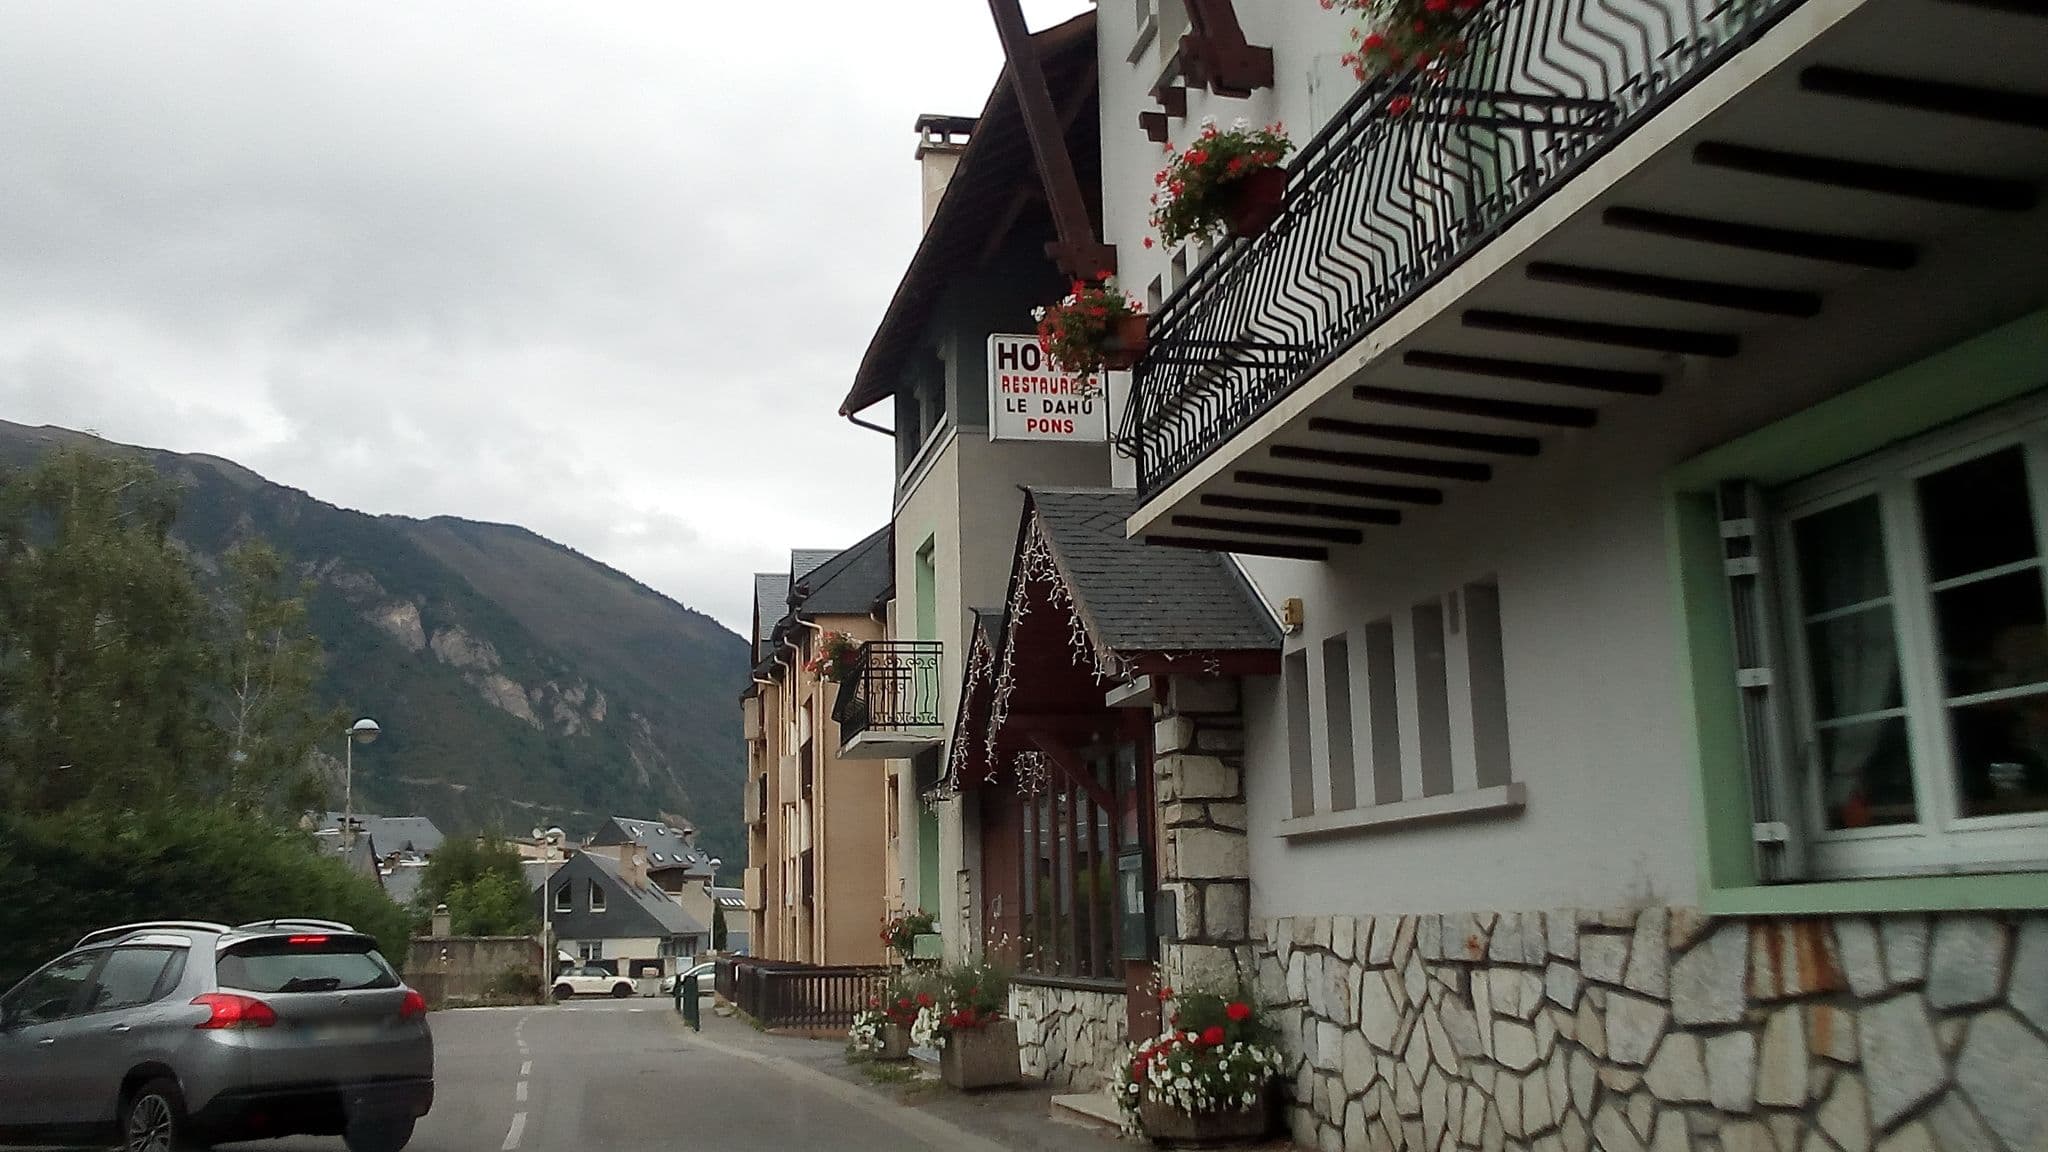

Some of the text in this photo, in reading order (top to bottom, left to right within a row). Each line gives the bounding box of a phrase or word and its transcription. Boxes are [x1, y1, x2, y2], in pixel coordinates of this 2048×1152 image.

[1001, 375, 1097, 395] RESTAUR
[1006, 398, 1093, 415] LE DAHU
[1026, 418, 1075, 434] PONS
